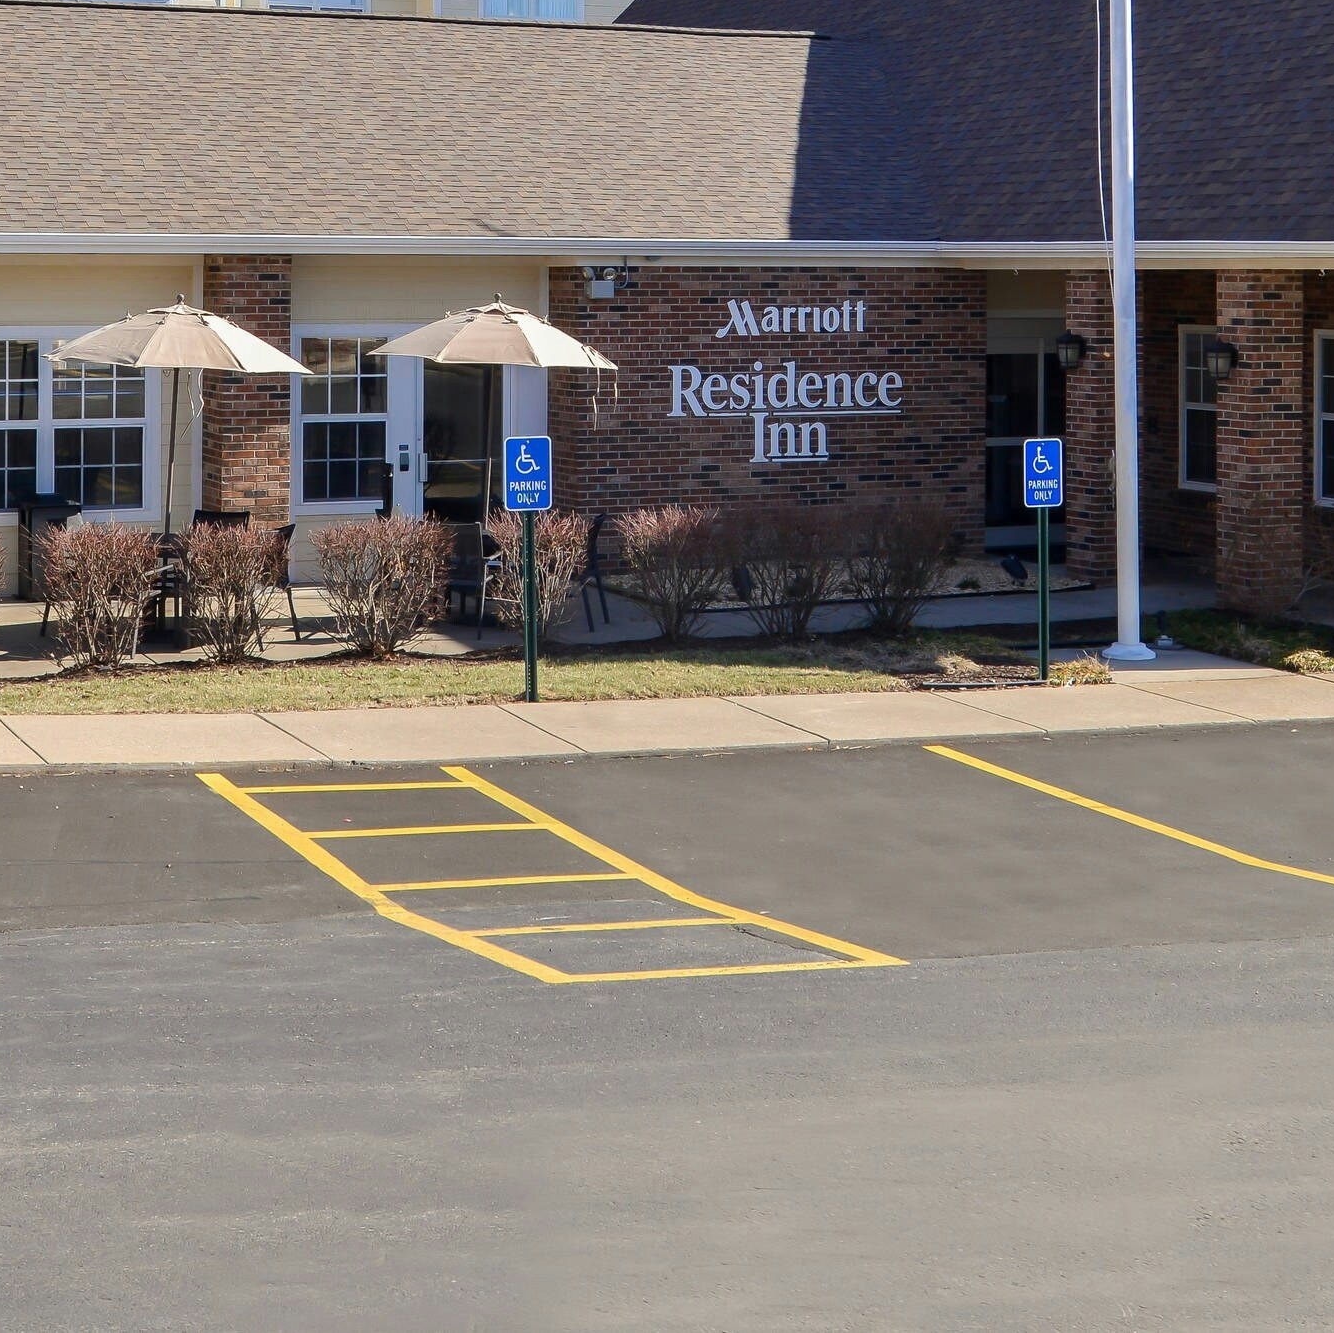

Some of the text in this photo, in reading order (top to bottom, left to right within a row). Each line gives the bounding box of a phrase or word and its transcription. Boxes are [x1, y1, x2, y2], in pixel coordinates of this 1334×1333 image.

[715, 299, 866, 338] Marriott
[667, 361, 903, 416] Residence
[749, 412, 829, 463] Inn
[509, 480, 547, 491] PARKING
[1028, 479, 1058, 489] PARKING
[517, 492, 540, 504] ONLY
[1034, 490, 1053, 500] ONLY
